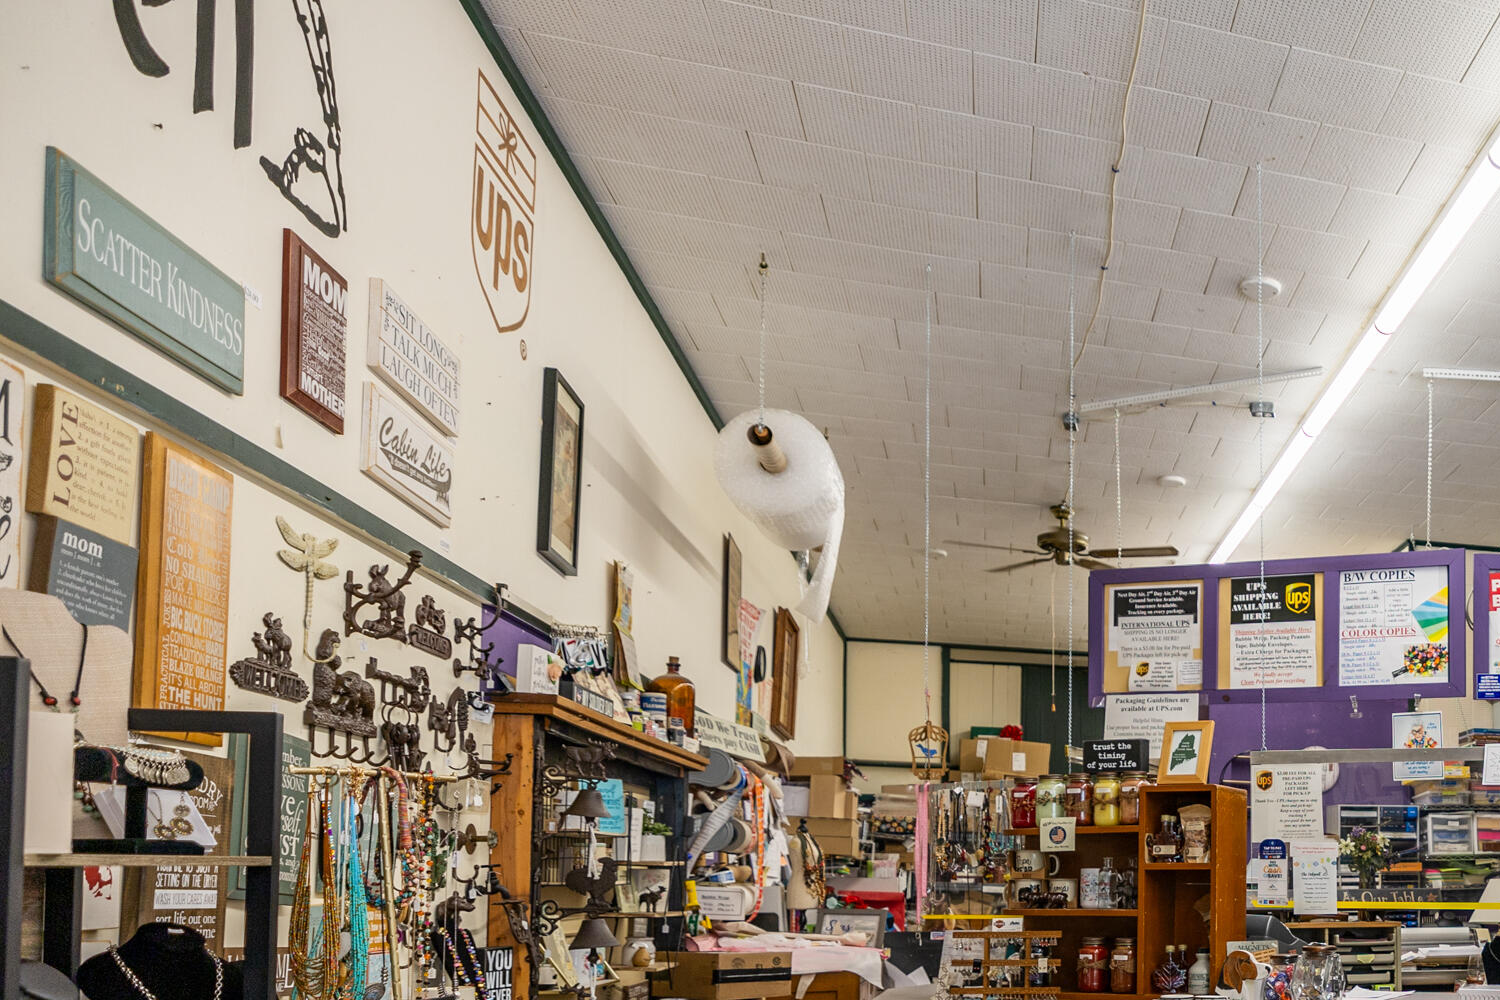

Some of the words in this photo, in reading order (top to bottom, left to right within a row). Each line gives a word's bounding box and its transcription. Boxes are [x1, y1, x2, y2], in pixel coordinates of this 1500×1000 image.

[474, 165, 531, 294] ups
[75, 197, 163, 296] SCATTER
[166, 260, 243, 357] KINDNESS
[304, 254, 348, 318] MOM
[399, 304, 417, 334] SIT
[419, 324, 448, 367] LONG
[392, 324, 419, 363] TALK
[422, 354, 451, 398] MUCH
[301, 371, 345, 419] MOTHER
[382, 346, 420, 397] LAUGH
[423, 387, 457, 428] OFTEN
[379, 416, 418, 465] Cabin
[53, 401, 79, 508] LOVE
[61, 531, 104, 559] mom
[1343, 572, 1366, 583] B/W
[1369, 569, 1416, 582] COPIES
[1246, 582, 1268, 592] UPS
[1233, 592, 1279, 602] SHIPPING
[1287, 591, 1309, 609] ups
[1231, 602, 1281, 611] AVAILABLE
[171, 606, 184, 629] BIG
[1175, 620, 1190, 628] UPS
[1242, 612, 1271, 621] HERE!
[1341, 628, 1377, 638] COLOR
[1379, 626, 1417, 637] COPIES
[168, 643, 206, 667] TRADITION
[168, 656, 194, 678] BLAZE
[184, 676, 197, 690] ALL
[198, 680, 223, 697] ABOUT
[168, 686, 191, 706] THE
[193, 690, 222, 711] HUNT
[1115, 697, 1146, 705] Packaging
[730, 725, 757, 743] Trust
[1117, 742, 1132, 750] the
[1087, 761, 1097, 769] of
[1098, 761, 1118, 769] your
[1098, 752, 1126, 760] timing
[1263, 865, 1282, 874] Cash
[155, 873, 180, 888] SETTING
[192, 872, 202, 887] THE
[1391, 891, 1424, 902] Table
[173, 911, 187, 925] life
[188, 914, 202, 925] out
[203, 914, 216, 924] one
[487, 950, 512, 971] YOU
[486, 971, 512, 989] WILL
